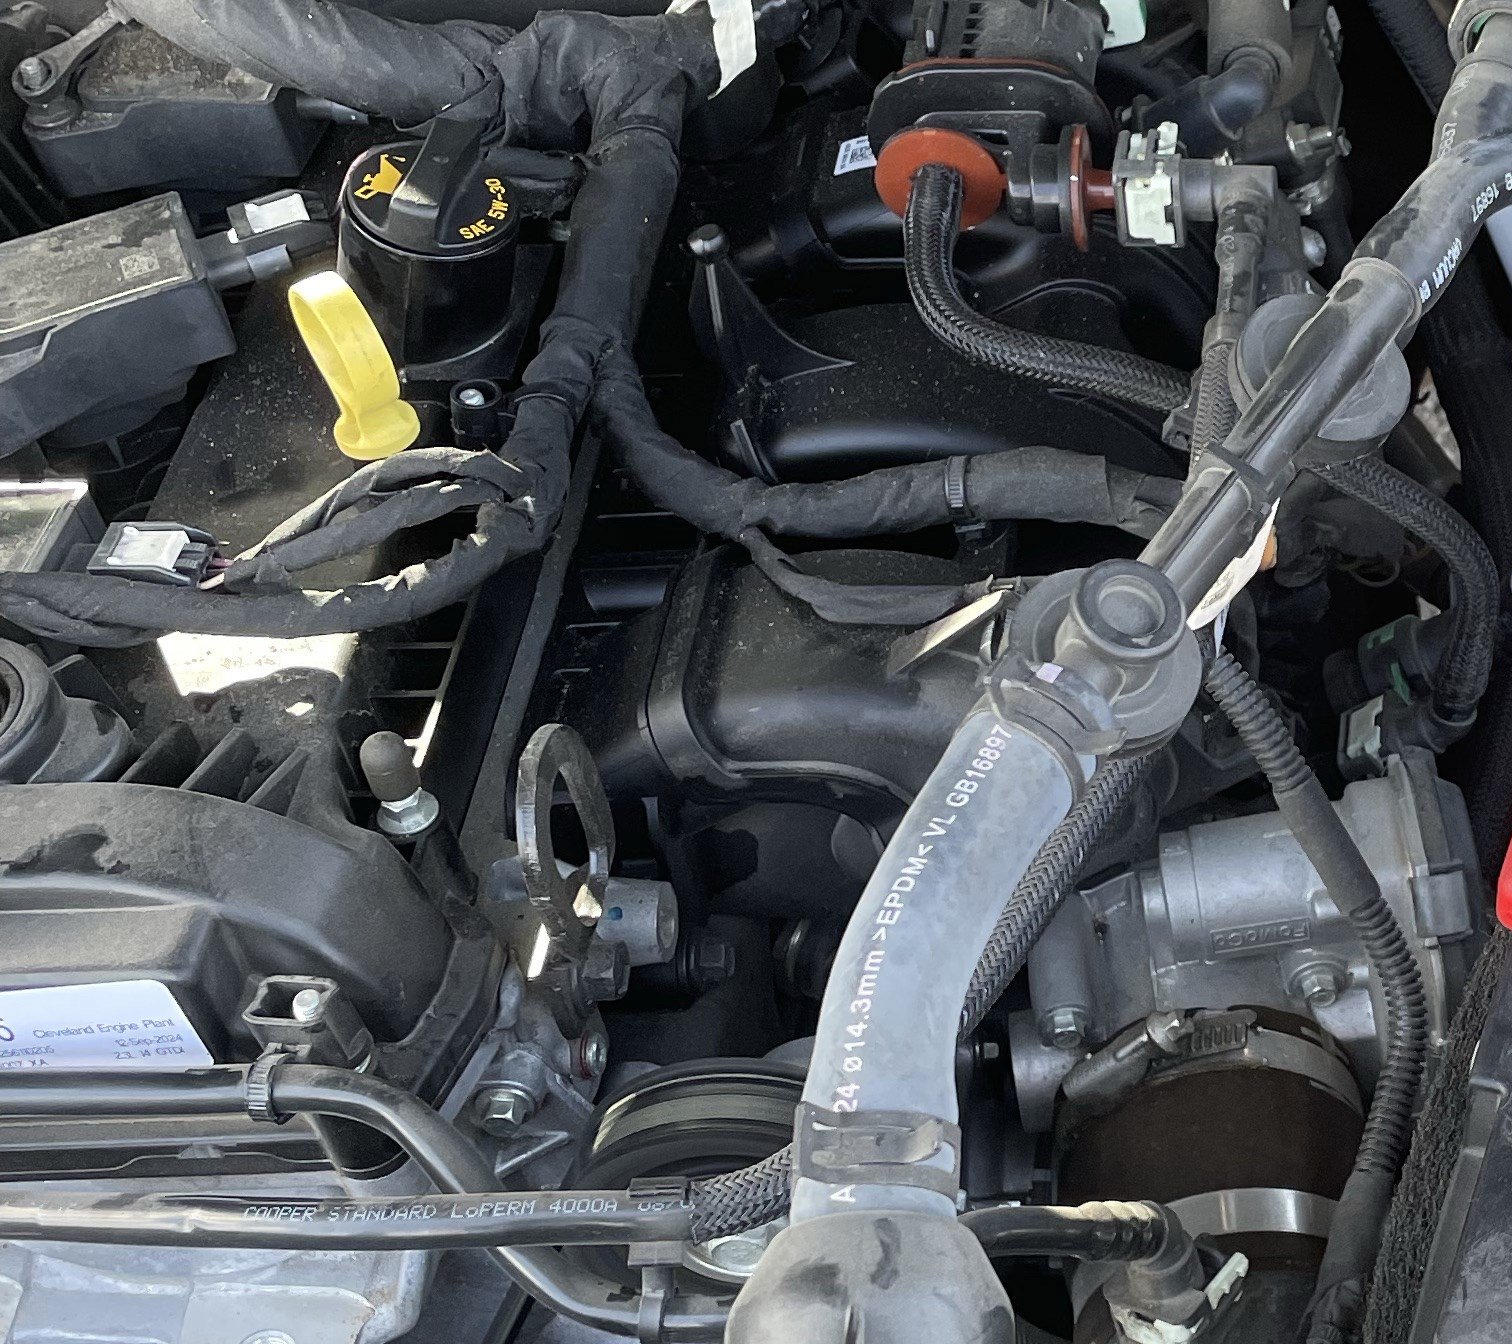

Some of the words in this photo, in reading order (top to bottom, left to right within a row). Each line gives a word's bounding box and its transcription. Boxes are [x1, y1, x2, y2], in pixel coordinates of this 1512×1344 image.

[459, 218, 494, 239] SAE
[485, 178, 508, 219] 5W-30
[1469, 182, 1499, 222] 16897
[922, 805, 958, 845] VL
[943, 722, 1014, 812] GB16897
[96, 1021, 139, 1034] Engine
[141, 1017, 175, 1028] Plant
[243, 1204, 316, 1222] COOPER
[326, 1202, 436, 1223] STANDARD
